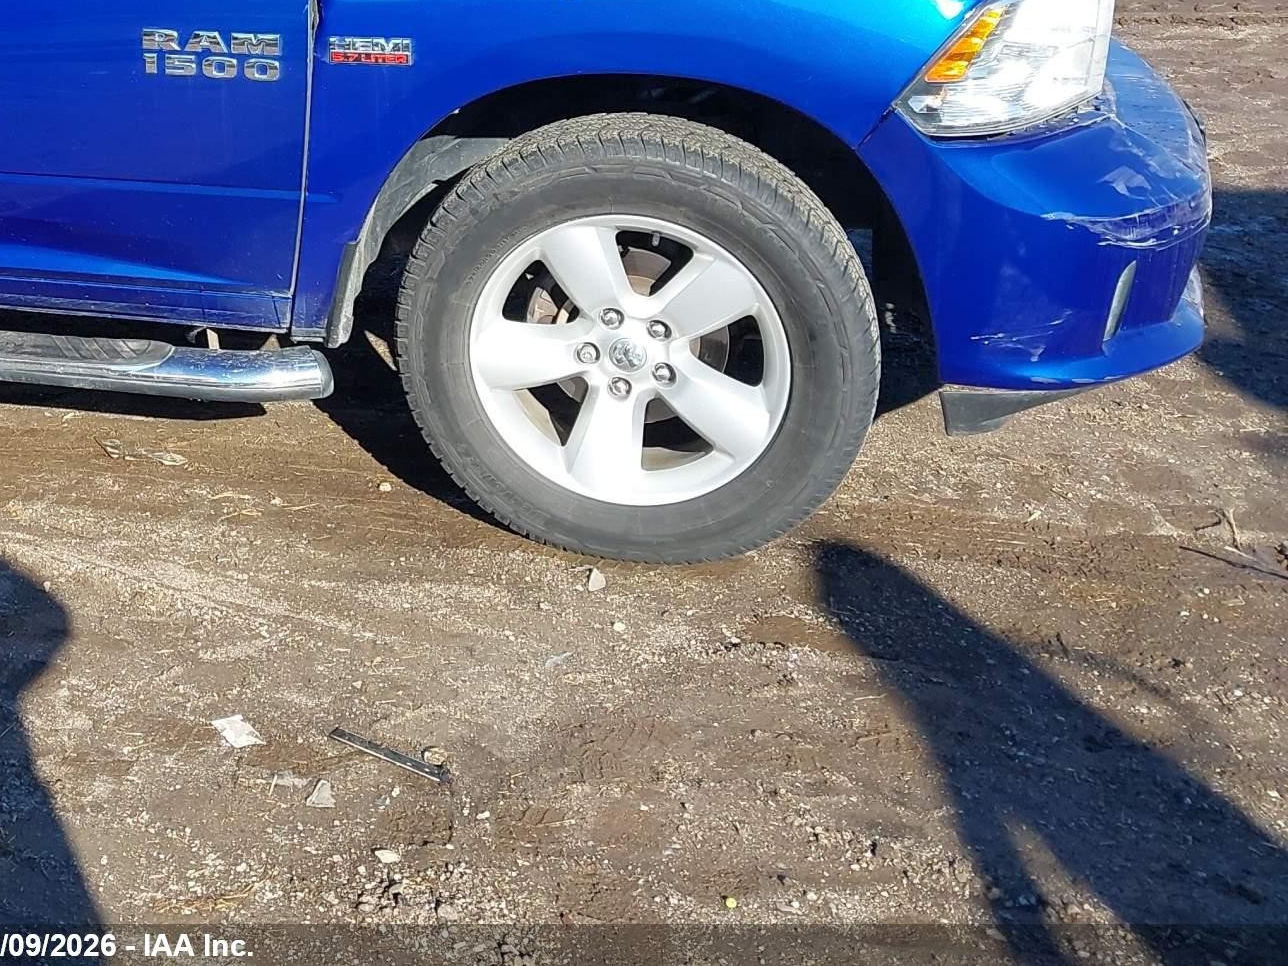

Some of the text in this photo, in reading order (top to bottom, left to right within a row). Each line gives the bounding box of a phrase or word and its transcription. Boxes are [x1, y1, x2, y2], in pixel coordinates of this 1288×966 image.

[142, 28, 281, 55] RAM
[329, 37, 411, 52] HEMI
[143, 52, 280, 81] 1500
[332, 52, 407, 63] 5.7 LITER
